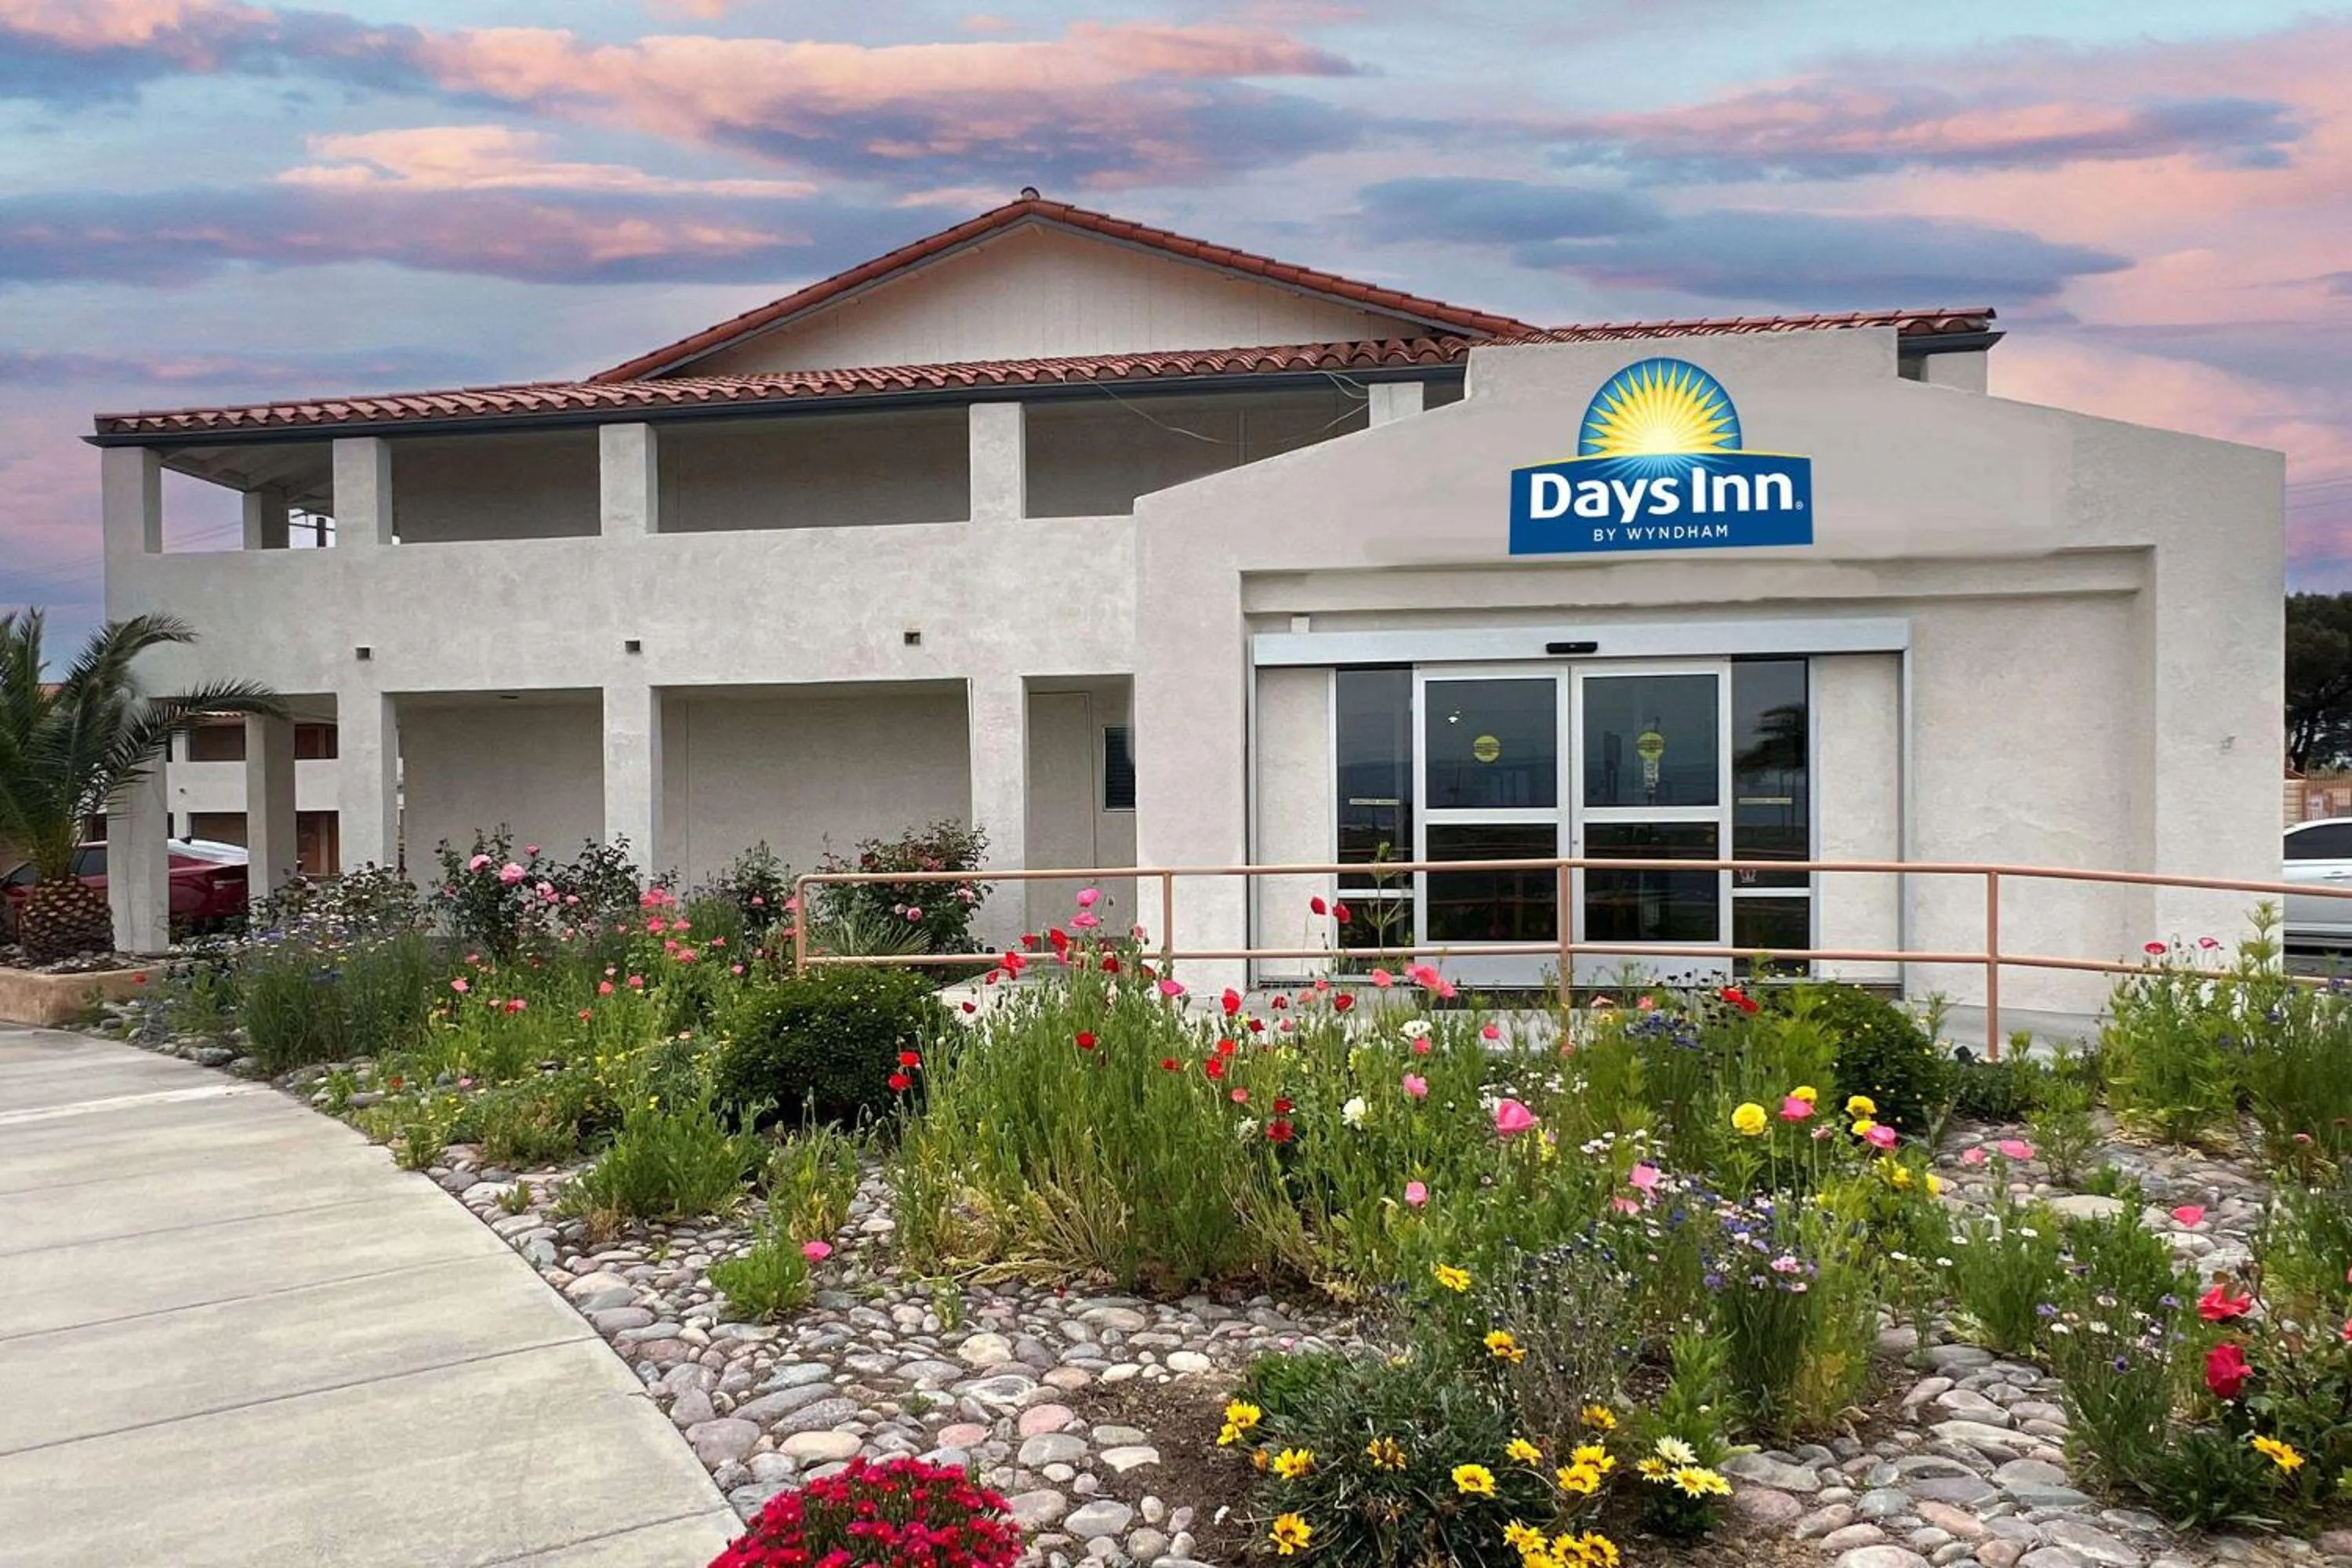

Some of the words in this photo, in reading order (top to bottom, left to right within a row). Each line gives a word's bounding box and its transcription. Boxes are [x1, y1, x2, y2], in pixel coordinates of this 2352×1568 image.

[1530, 473, 1680, 523] Days
[1692, 466, 1794, 514] Inn
[1593, 528, 1616, 542] BY
[1627, 524, 1728, 539] WYNDHAM
